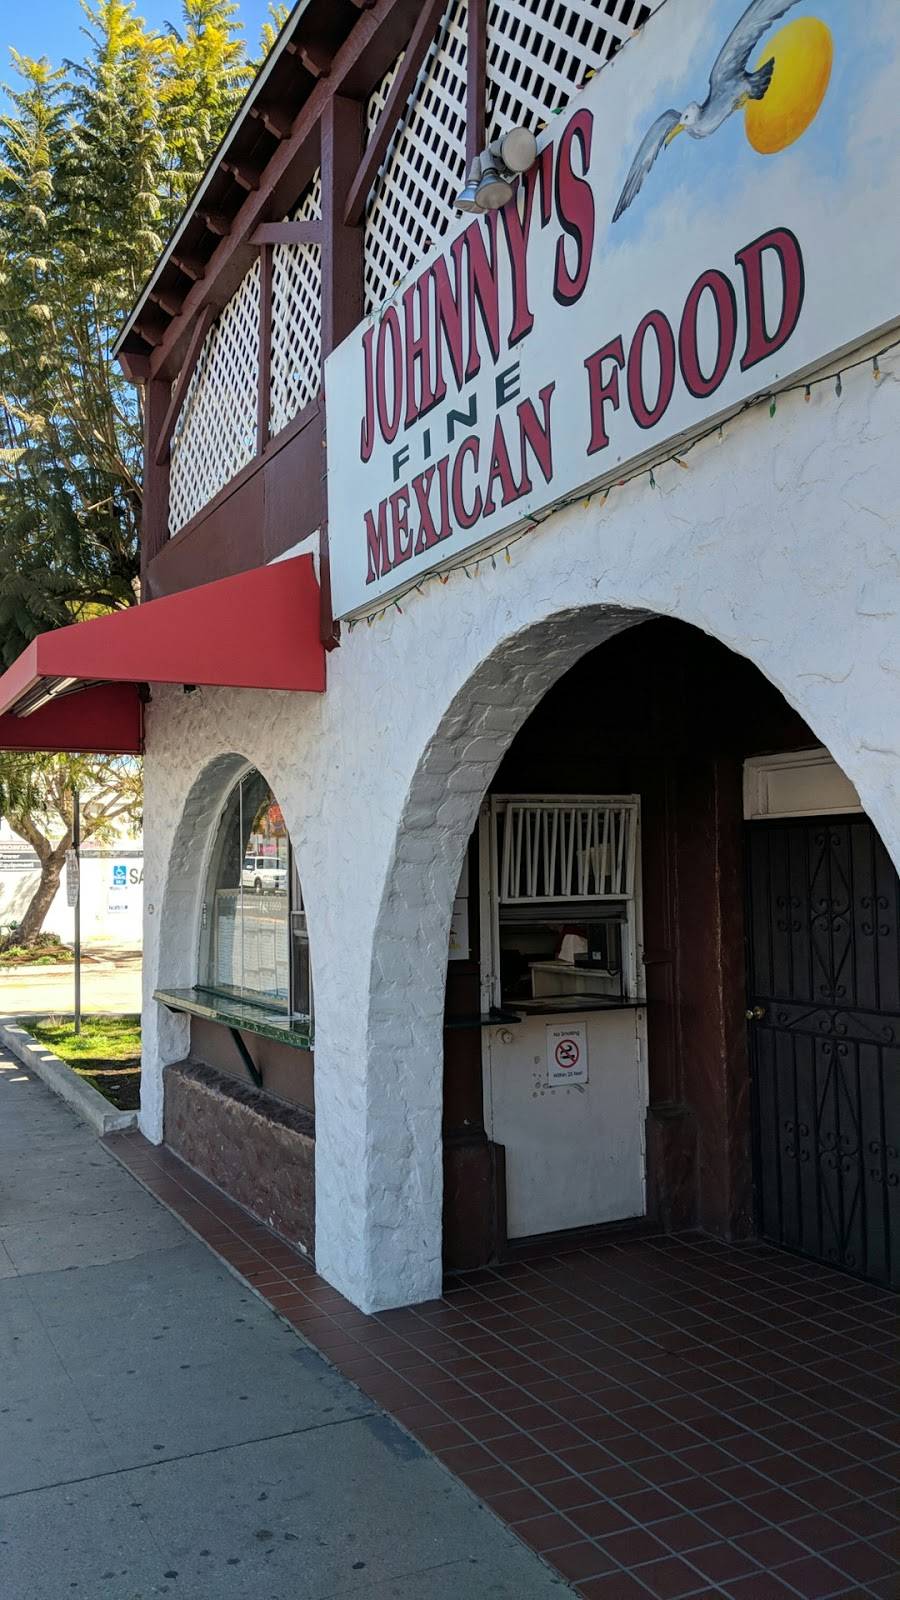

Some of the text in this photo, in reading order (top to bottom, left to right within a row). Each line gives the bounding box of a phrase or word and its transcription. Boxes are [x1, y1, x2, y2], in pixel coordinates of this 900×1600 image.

[361, 107, 596, 464] JOHNNY'S
[363, 226, 806, 585] MEXICAN FOOD
[391, 360, 521, 482] FINE
